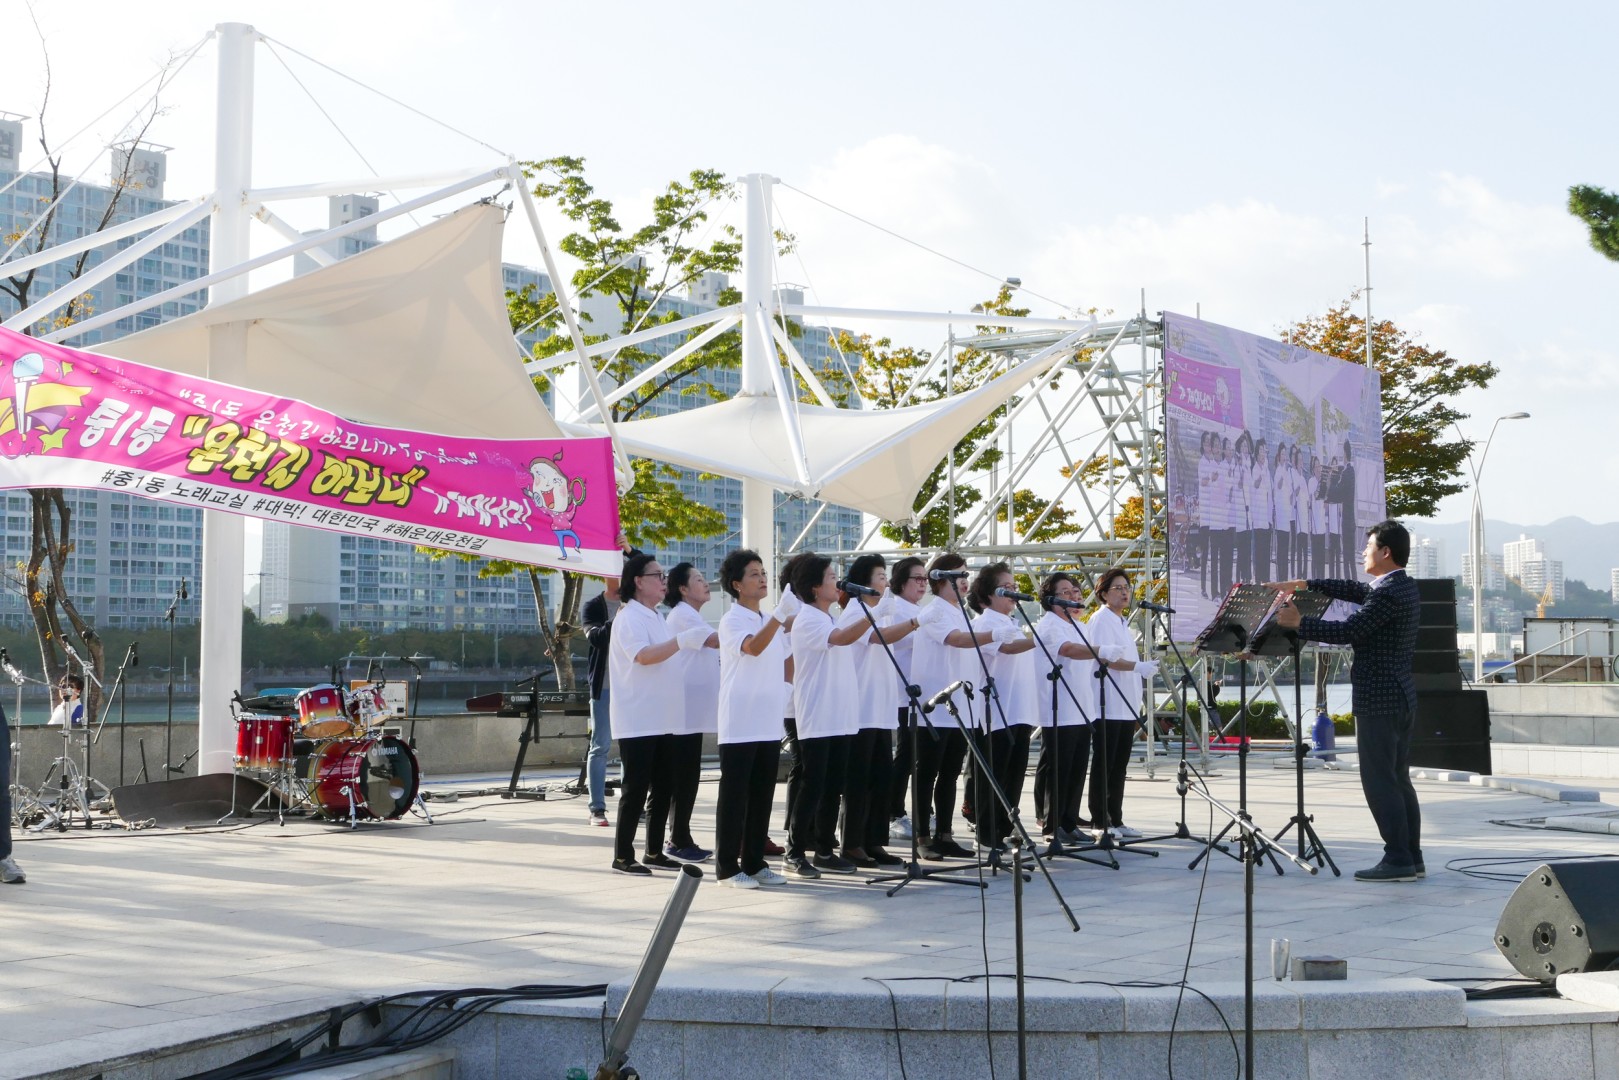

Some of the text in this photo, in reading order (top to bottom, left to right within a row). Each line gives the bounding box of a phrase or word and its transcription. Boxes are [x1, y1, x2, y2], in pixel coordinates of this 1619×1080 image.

[253, 410, 320, 440] 온천길
[100, 469, 489, 550] #중1동 노래교실 #대박! 대한민국 #해운대온천길
[378, 746, 398, 756] YAMAHA
